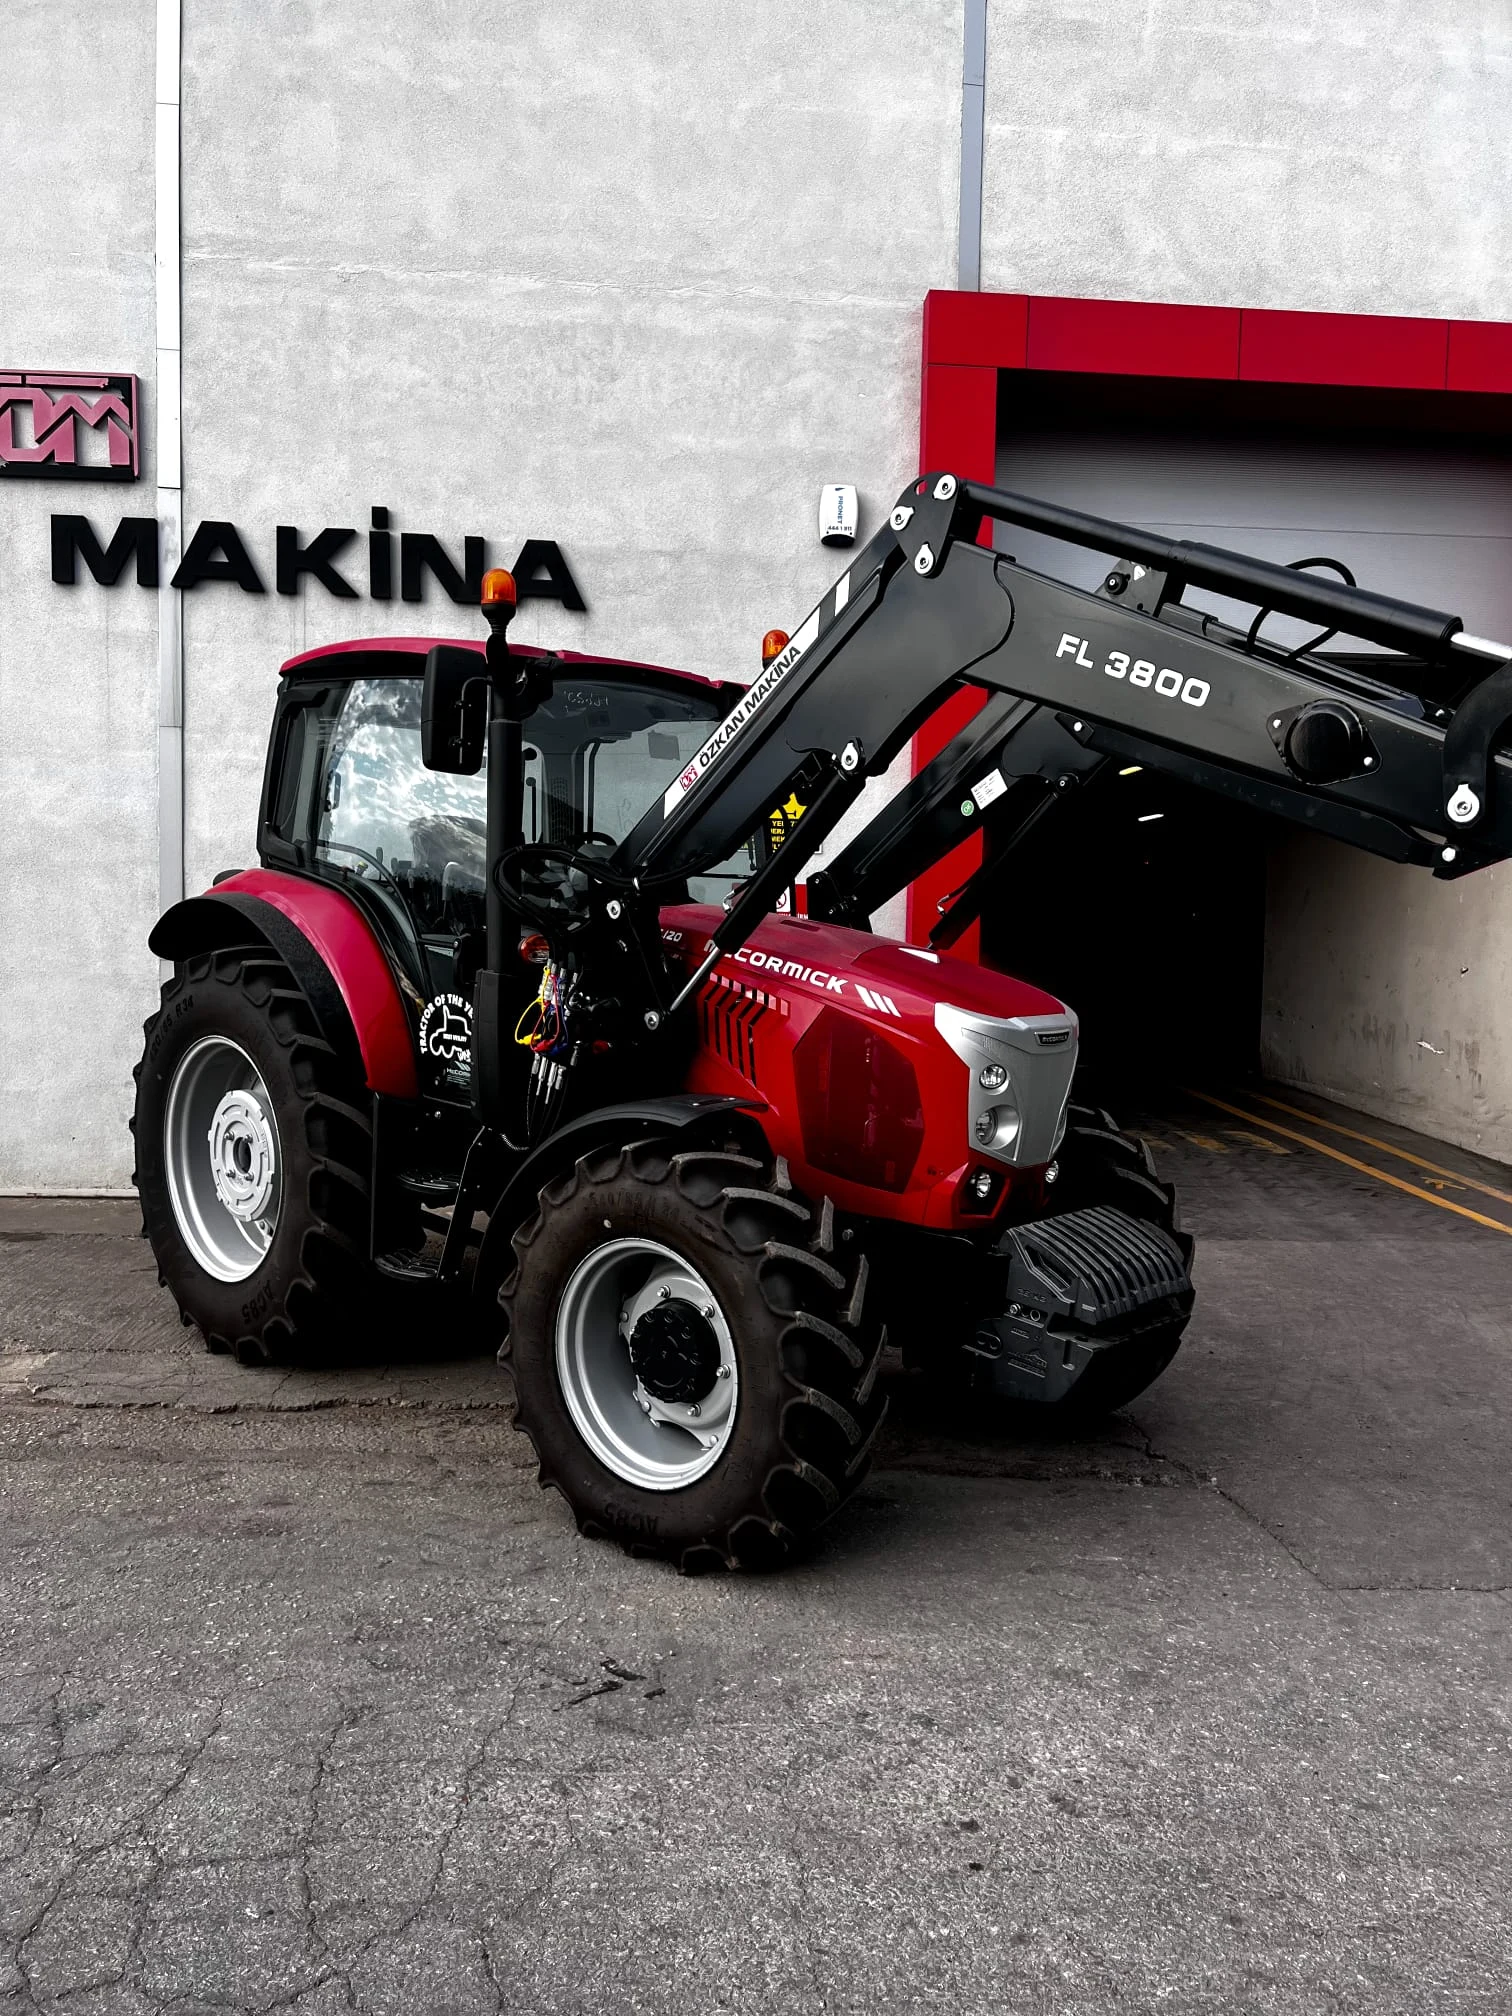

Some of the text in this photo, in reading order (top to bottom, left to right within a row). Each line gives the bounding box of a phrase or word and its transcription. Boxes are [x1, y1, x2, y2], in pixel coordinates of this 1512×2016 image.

[51, 506, 587, 611] MAKİNA
[700, 710, 746, 768] ÖZKAN
[744, 646, 802, 714] MAKİNA
[1056, 633, 1211, 707] FL 3800
[419, 1003, 436, 1055] TRACTOR
[434, 994, 446, 1008] OF
[447, 994, 464, 1008] THE
